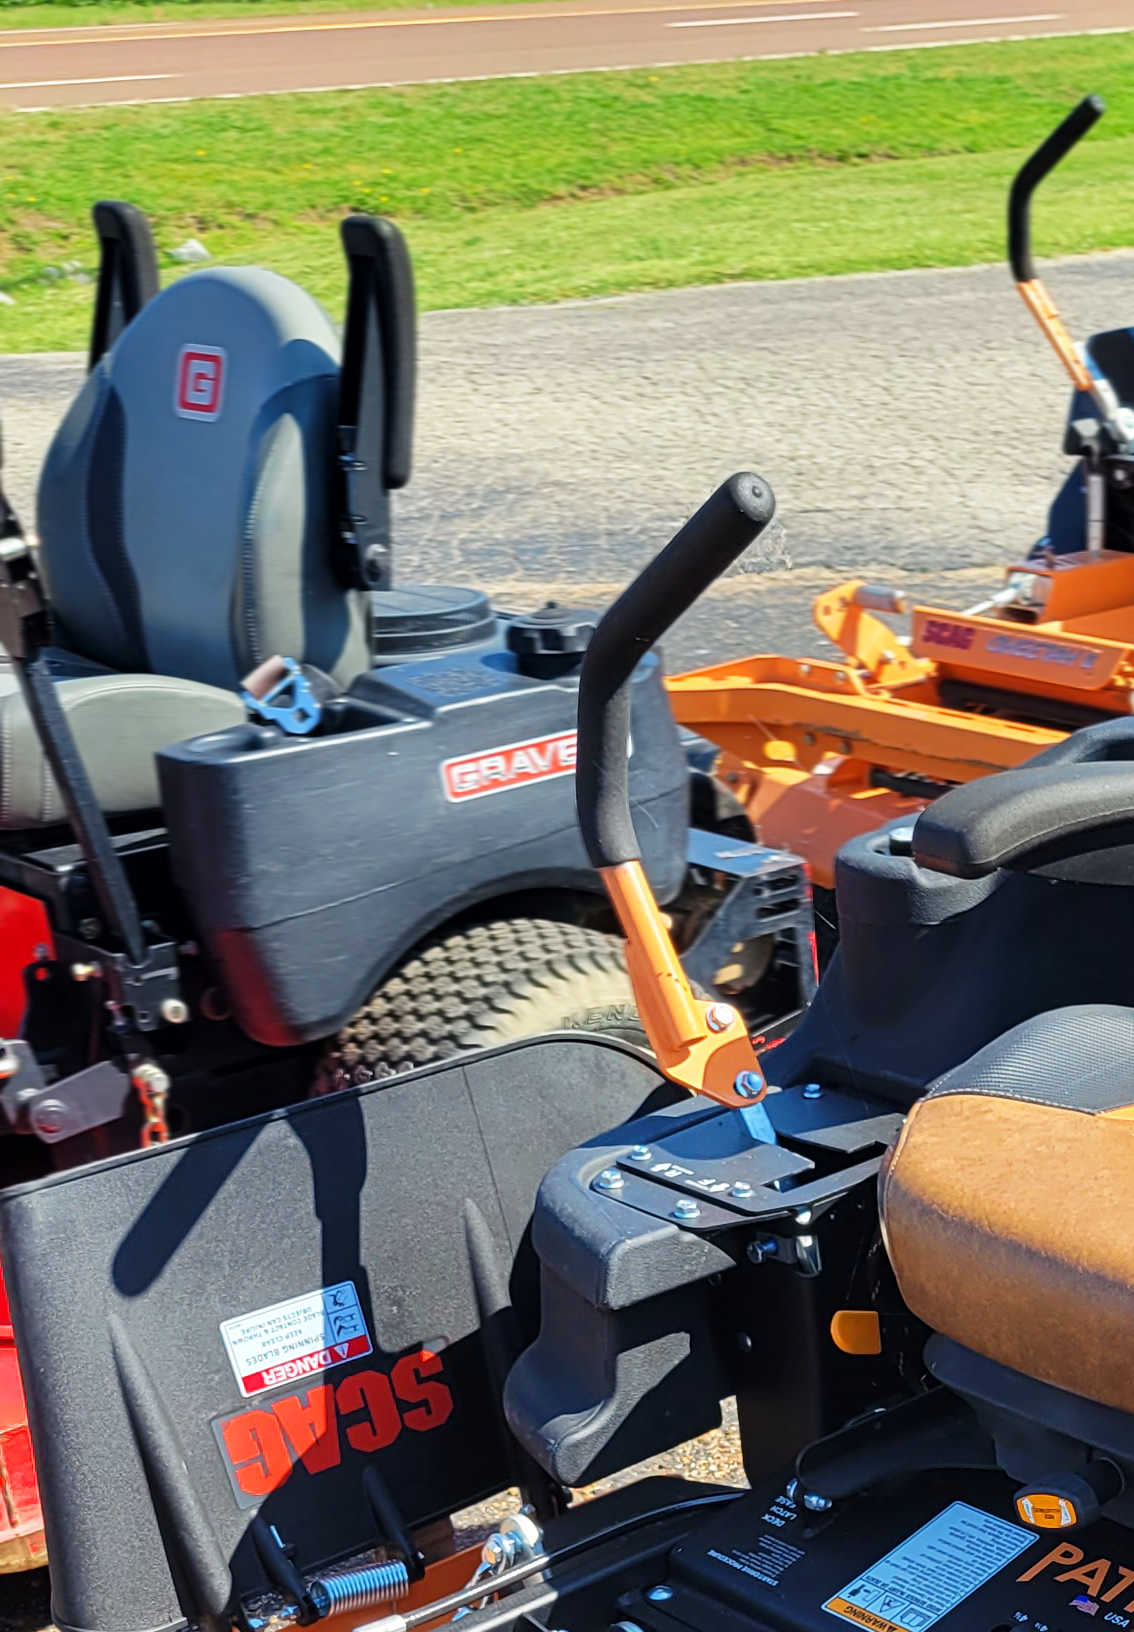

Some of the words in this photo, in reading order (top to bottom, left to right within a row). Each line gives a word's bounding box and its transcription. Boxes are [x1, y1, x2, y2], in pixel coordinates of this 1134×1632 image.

[450, 737, 578, 793] GRAVE
[283, 1306, 313, 1320] OBJECTS
[303, 1310, 325, 1324] BLADE
[241, 1322, 266, 1335] INJURE
[267, 1317, 281, 1327] CAN
[271, 1317, 302, 1333] CONTACT
[232, 1331, 262, 1345] THROWN
[261, 1335, 284, 1347] CLEAR
[285, 1329, 303, 1339] KEEP
[281, 1332, 325, 1353] SPINNING
[245, 1347, 281, 1366] BLADES
[261, 1350, 333, 1386] DANGER
[222, 1349, 454, 1497] SCAG
[770, 1505, 798, 1520] LATCH
[761, 1513, 786, 1528] DECK
[843, 1605, 889, 1632] WARNING
[1103, 1611, 1131, 1628] USA
